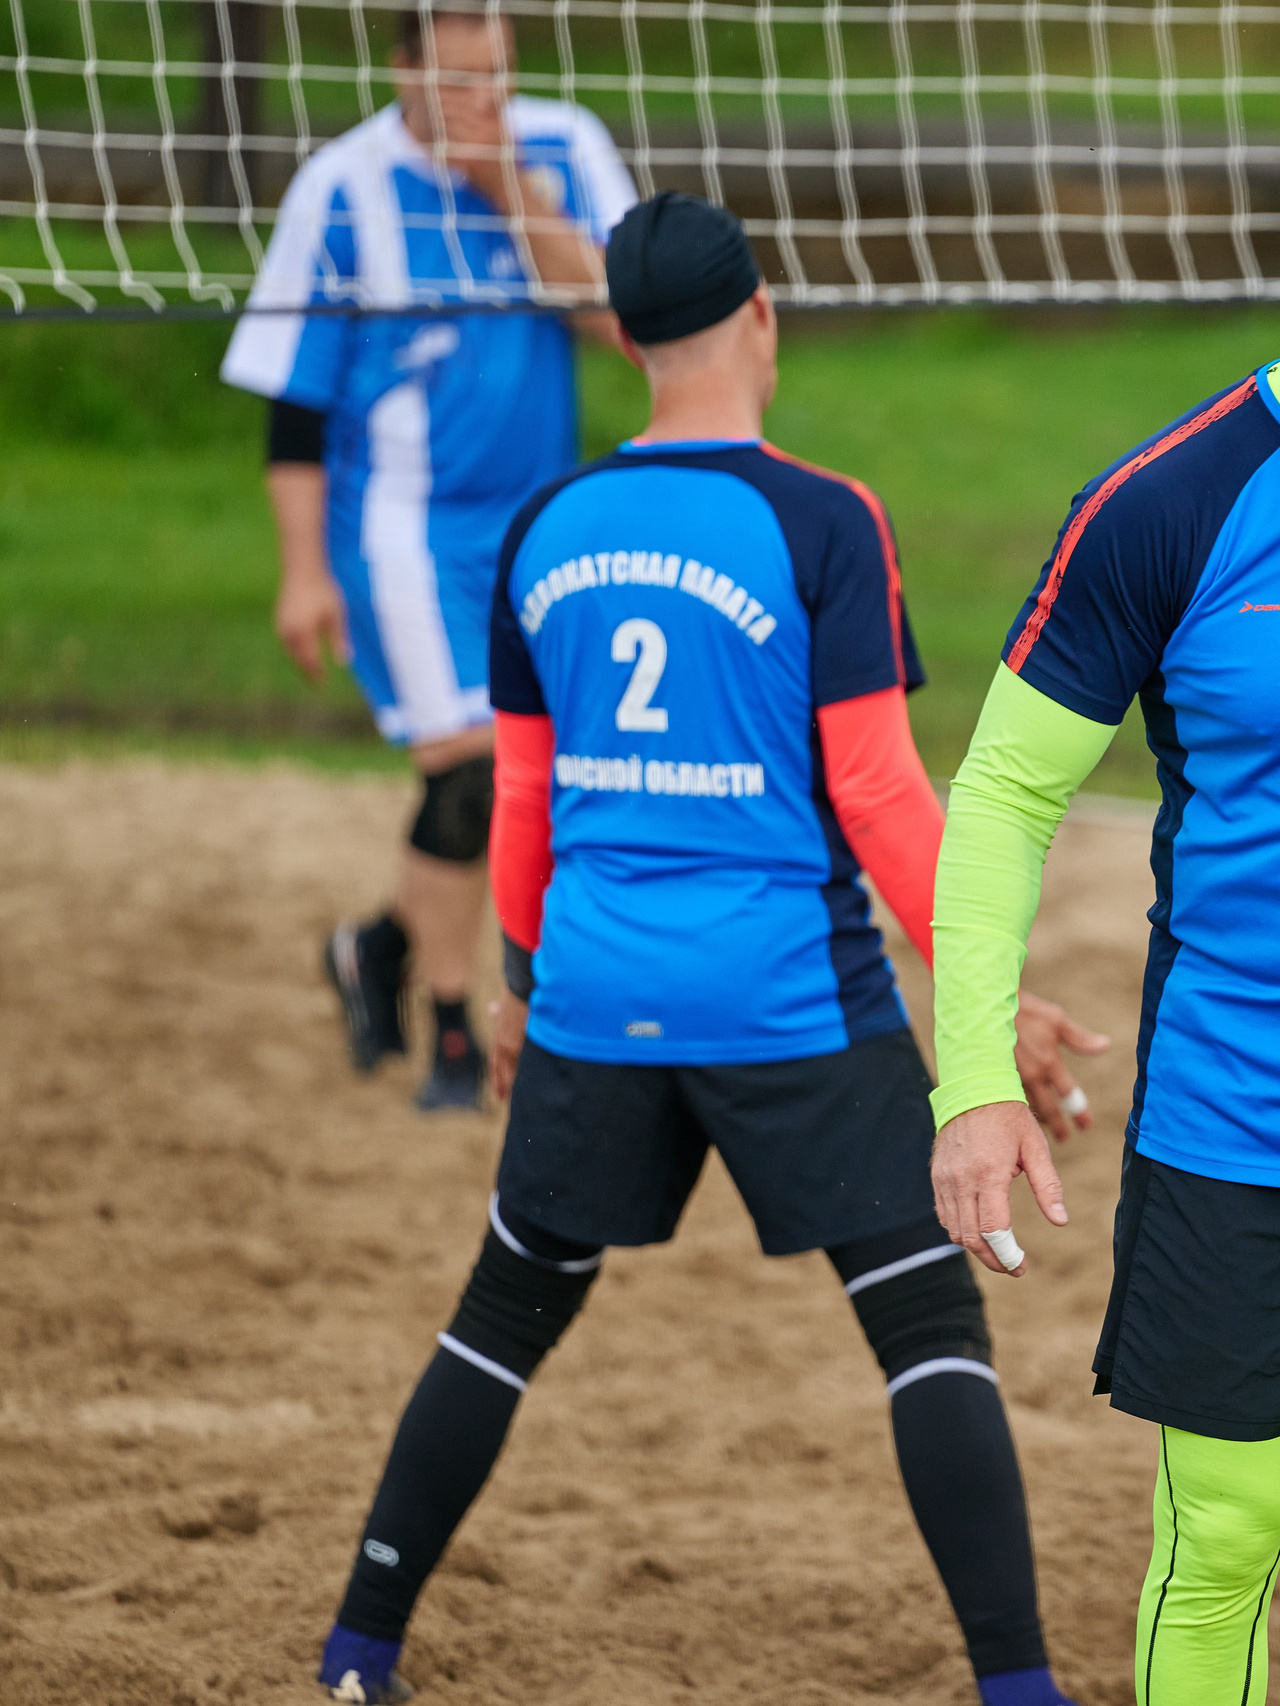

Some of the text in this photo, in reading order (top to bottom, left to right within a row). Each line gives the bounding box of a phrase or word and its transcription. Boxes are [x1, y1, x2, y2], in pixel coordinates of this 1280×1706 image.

[679, 558, 777, 646] ПАЛАТА
[611, 617, 669, 733] 2
[645, 760, 765, 797] ОБЛАСТИ
